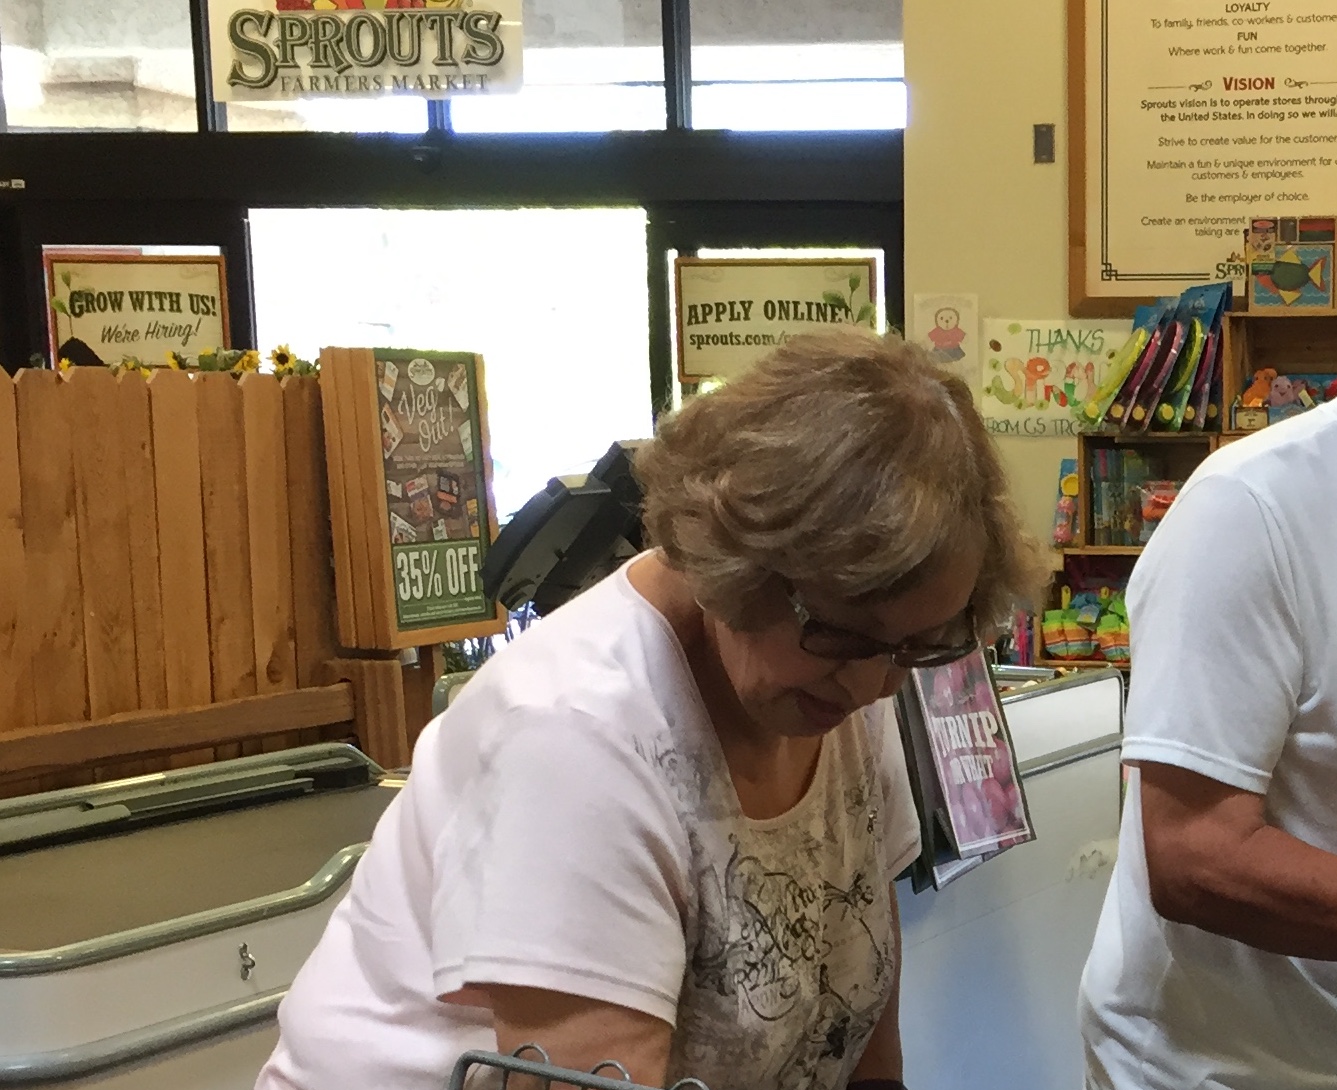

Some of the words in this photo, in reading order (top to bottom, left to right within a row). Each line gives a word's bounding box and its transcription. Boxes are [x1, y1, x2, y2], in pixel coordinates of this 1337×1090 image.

[1225, 2, 1271, 13] LOYALTY
[1150, 18, 1162, 29] To
[1286, 14, 1293, 24] &
[1237, 31, 1258, 41] FUN
[226, 8, 505, 88] SPROUTS
[1168, 46, 1200, 57] Where
[1202, 45, 1226, 55] work
[1228, 45, 1235, 54] &
[1237, 44, 1253, 54] fun
[1255, 45, 1282, 54] come
[280, 74, 383, 92] FARMERS
[391, 73, 490, 94] MARKET
[1140, 99, 1177, 111] Sprouts
[1179, 98, 1208, 108] vision
[1209, 97, 1218, 107] is
[1220, 97, 1230, 107] to
[1232, 97, 1270, 109] operate
[1272, 96, 1302, 106] stores
[1160, 112, 1176, 122] the
[1178, 111, 1210, 122] United
[1212, 111, 1244, 121] States.
[1246, 110, 1255, 120] In
[1257, 110, 1285, 121] doing
[1287, 110, 1299, 119] so
[1301, 110, 1317, 118] we
[1158, 136, 1185, 147] Strive
[1187, 137, 1198, 147] to
[1200, 137, 1229, 146] create
[1232, 135, 1257, 145] value
[1259, 135, 1273, 145] for
[1275, 134, 1291, 144] the
[1147, 160, 1186, 170] Maintain
[1188, 161, 1195, 169] a
[1197, 159, 1212, 169] fun
[1214, 159, 1222, 169] &
[1223, 158, 1255, 170] unique
[1257, 157, 1317, 167] environment
[1318, 157, 1332, 167] for
[1191, 170, 1240, 181] customers
[1242, 170, 1249, 180] &
[1185, 193, 1197, 203] Be
[1200, 192, 1217, 203] the
[1218, 192, 1262, 204] employer
[1264, 192, 1275, 201] of
[1141, 215, 1172, 226] Create
[1174, 217, 1187, 226] an
[1188, 215, 1246, 226] environment
[1194, 227, 1223, 239] taking
[1225, 227, 1240, 237] are
[1215, 262, 1246, 280] SPR
[69, 289, 125, 318] GROW
[127, 290, 183, 314] WITH
[187, 293, 218, 317] US!
[687, 300, 754, 326] APPLY
[100, 323, 141, 344] We're
[143, 317, 202, 347] Hiring!
[1026, 327, 1105, 354] THANKS
[397, 384, 438, 425] Veg
[985, 417, 1020, 435] FROM
[396, 549, 443, 601] 35%
[446, 546, 479, 595] OFF
